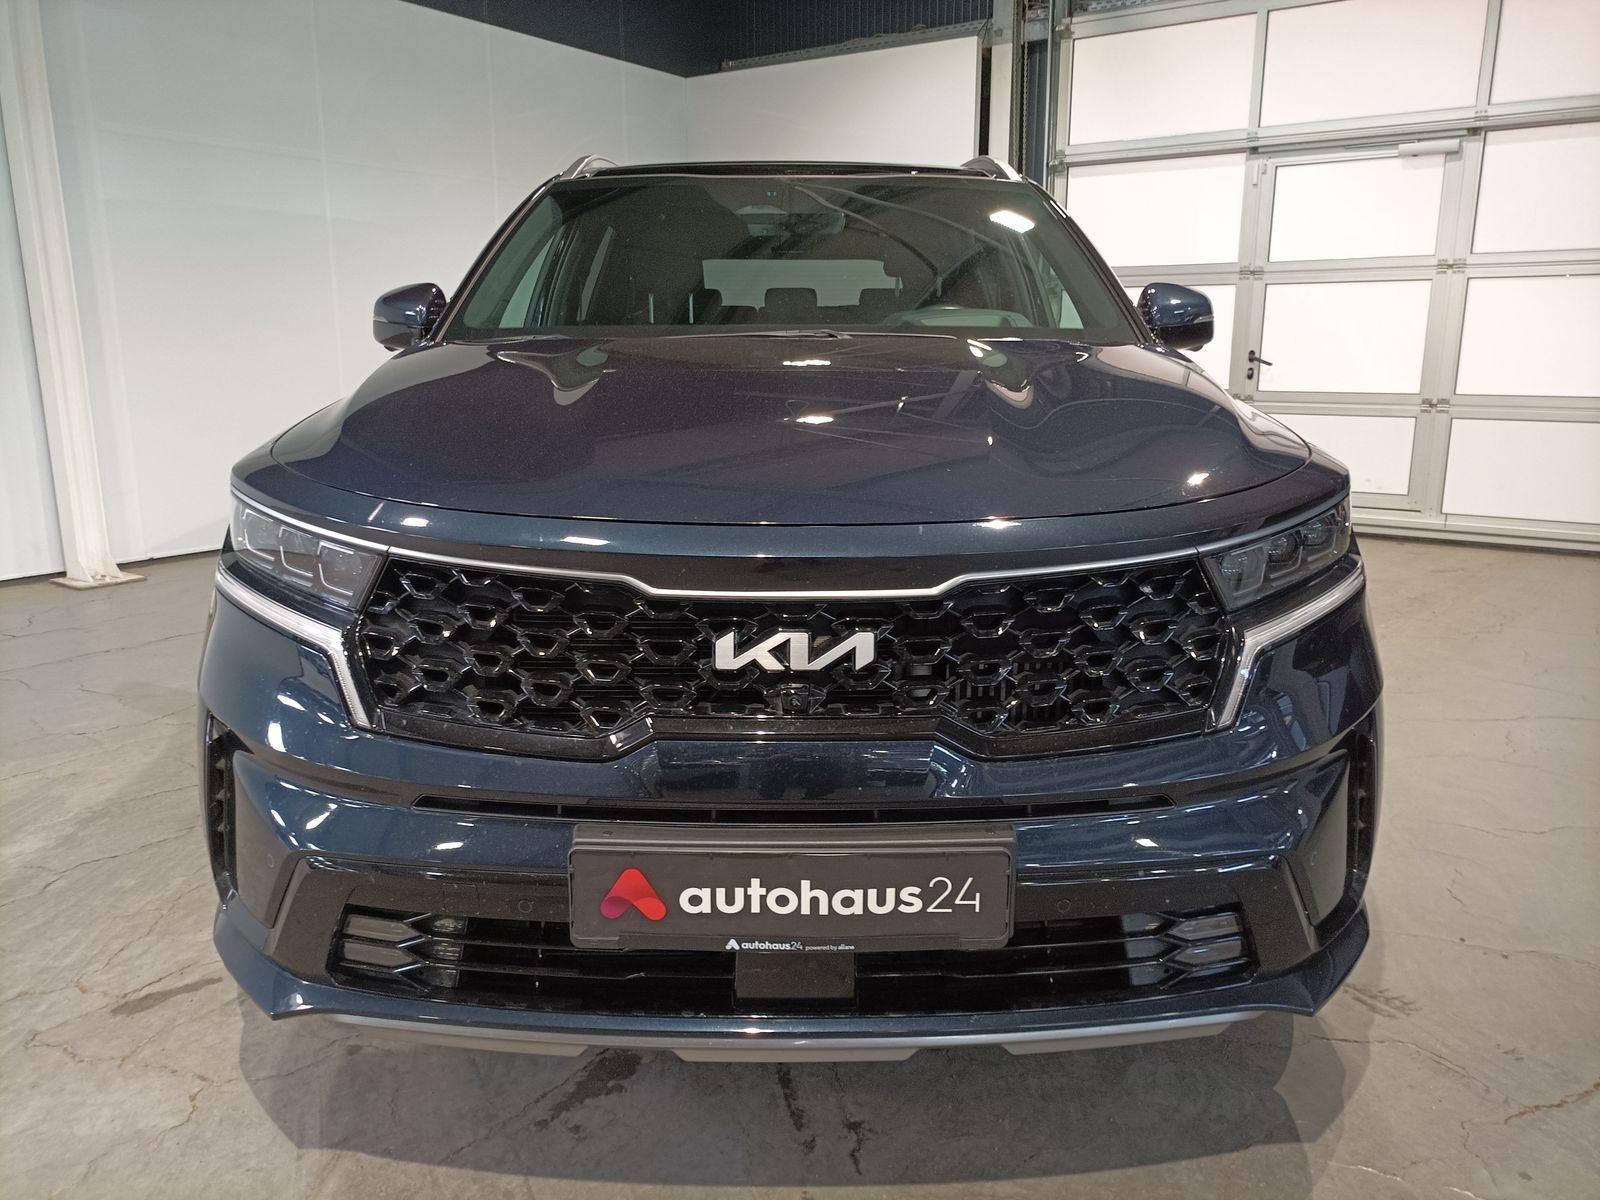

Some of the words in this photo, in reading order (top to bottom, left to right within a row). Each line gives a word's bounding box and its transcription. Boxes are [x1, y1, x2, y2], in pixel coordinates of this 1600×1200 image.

[715, 631, 875, 671] KIA
[678, 876, 981, 915] autohaus24
[741, 941, 803, 951] autohaus24
